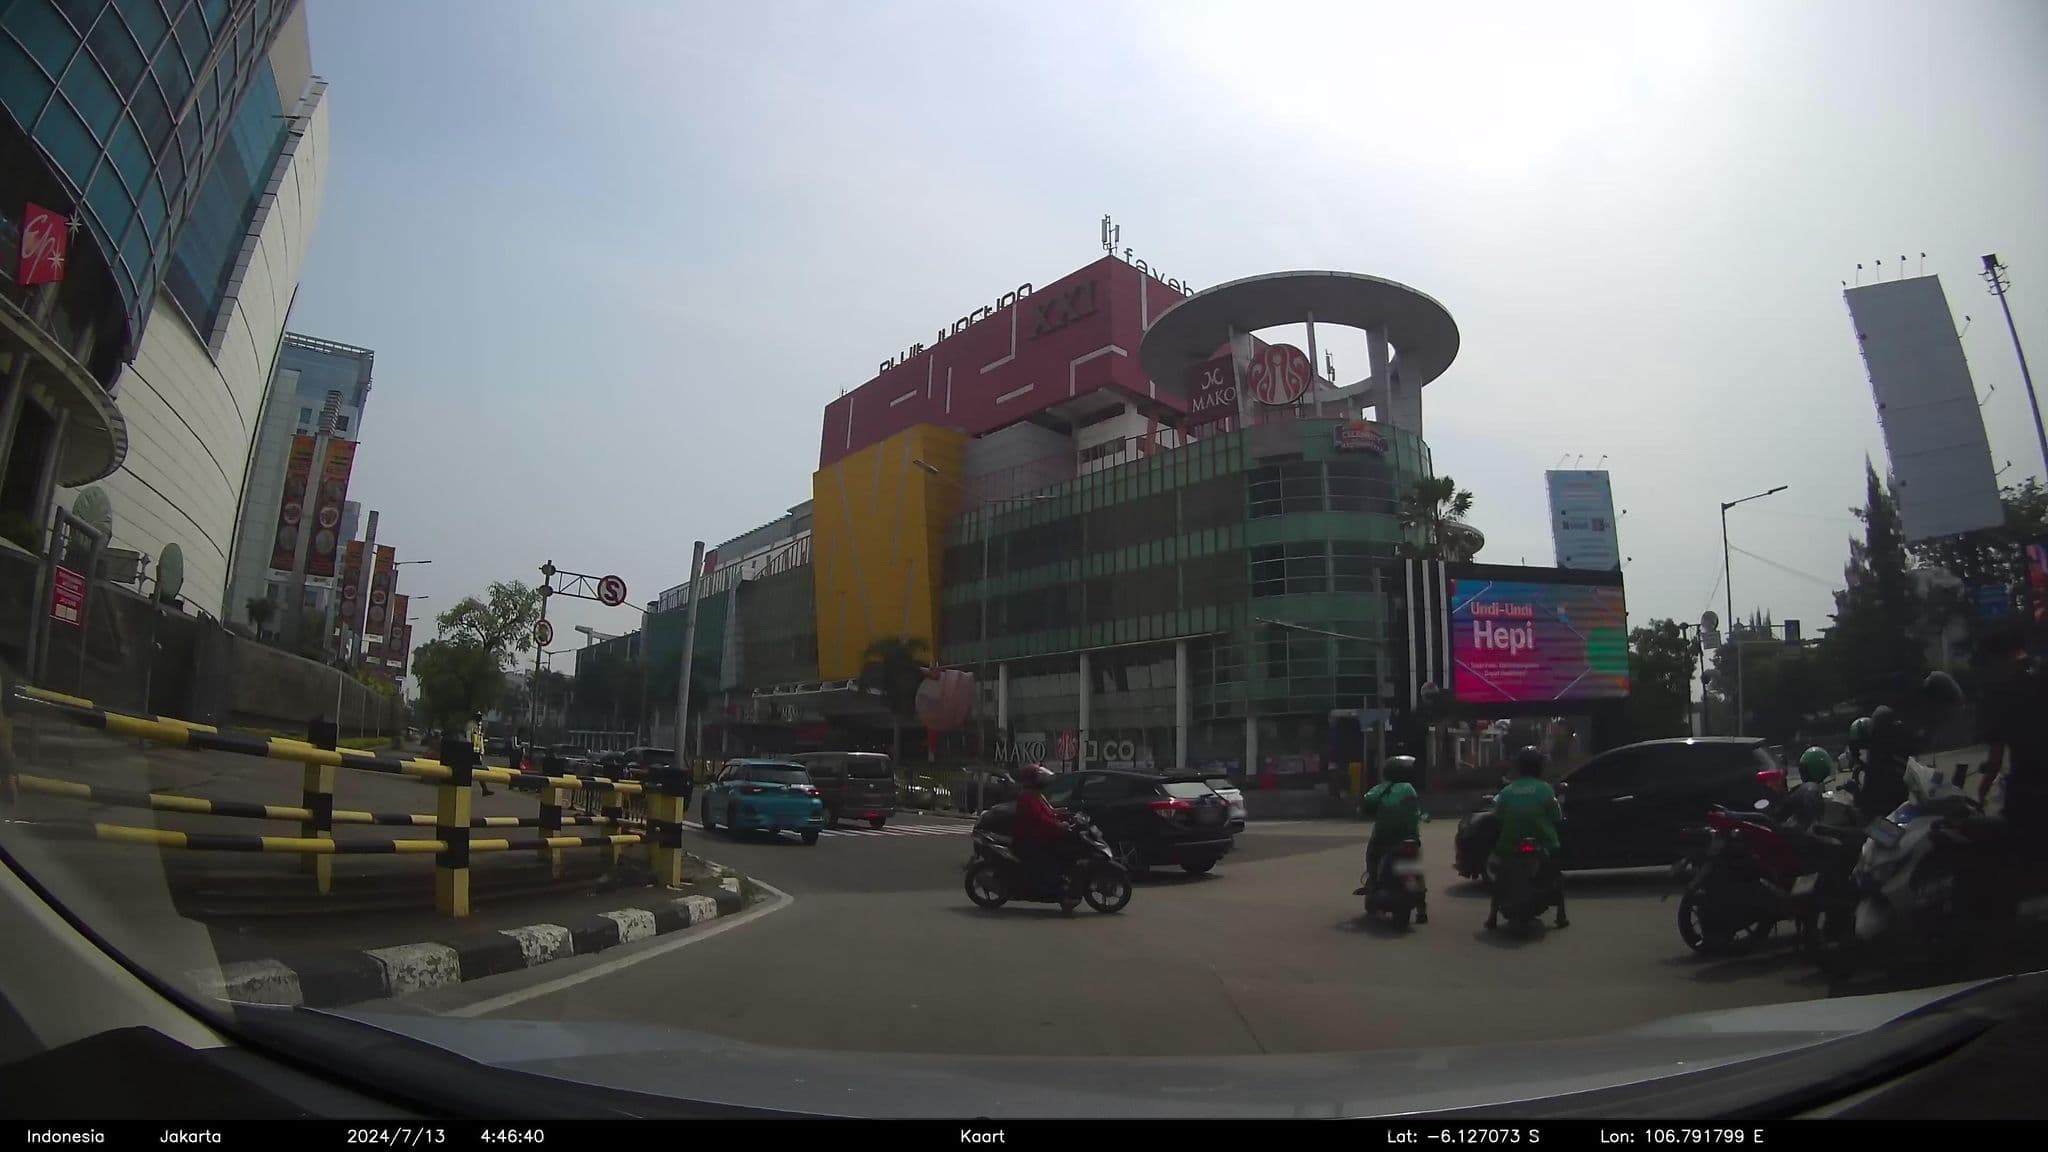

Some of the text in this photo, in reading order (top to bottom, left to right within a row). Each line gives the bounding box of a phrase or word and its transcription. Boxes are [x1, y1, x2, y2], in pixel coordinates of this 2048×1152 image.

[1027, 281, 1099, 341] XXI
[1191, 386, 1237, 413] MAKO
[1470, 602, 1533, 617] Undi-Undi
[1473, 620, 1534, 656] Hepi
[994, 741, 1046, 763] MAKO
